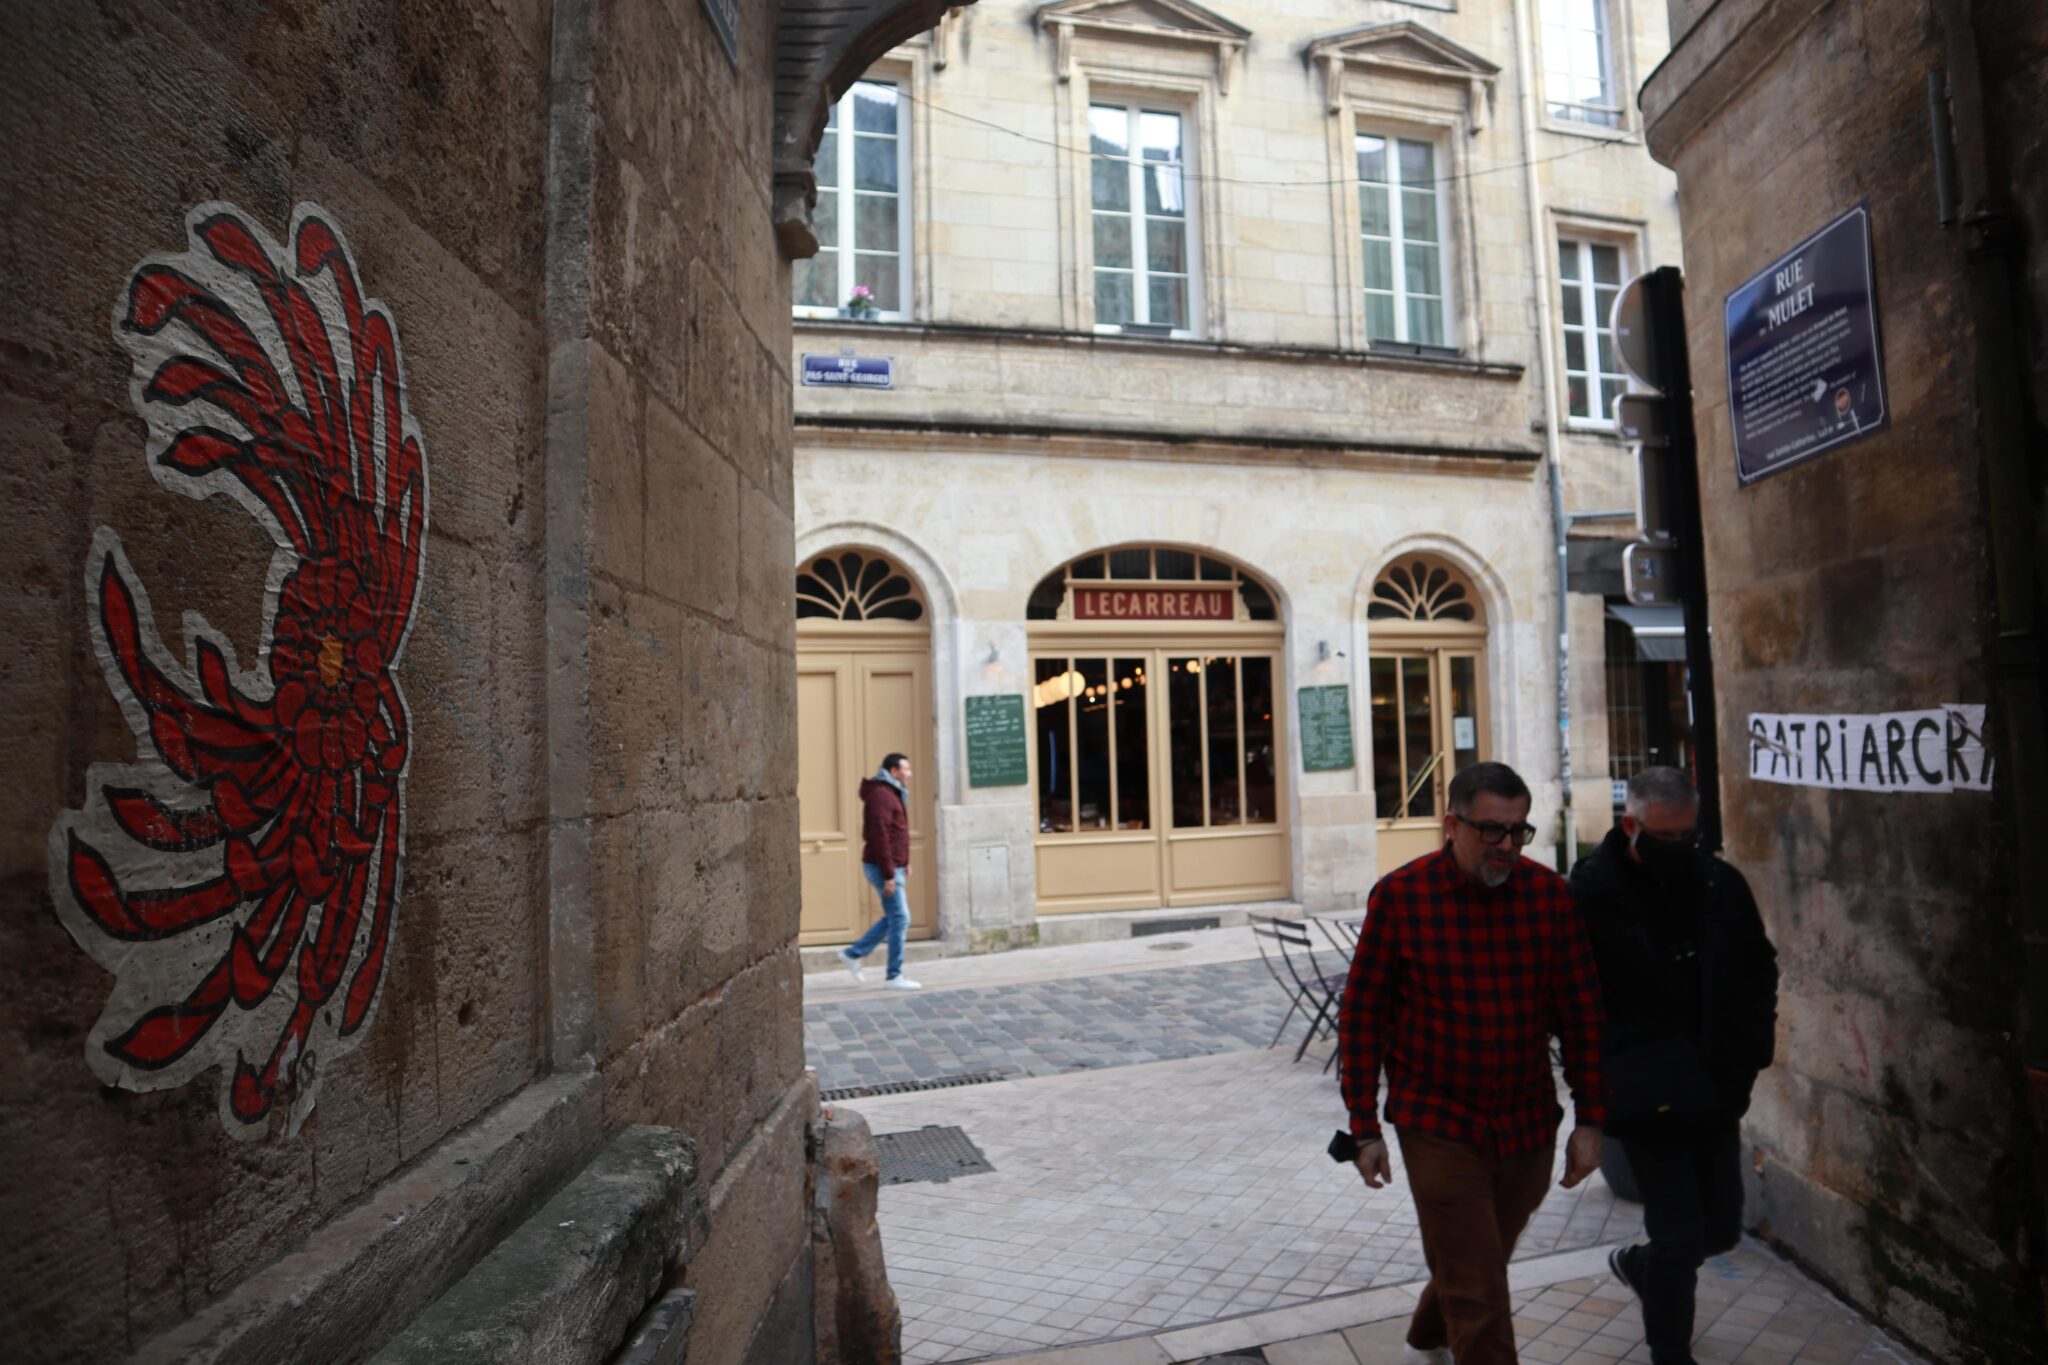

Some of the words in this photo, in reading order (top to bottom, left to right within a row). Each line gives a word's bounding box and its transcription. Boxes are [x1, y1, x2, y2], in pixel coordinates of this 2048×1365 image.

[1776, 258, 1804, 296] RUE
[1768, 282, 1816, 331] MULET
[1084, 591, 1223, 617] LECARREAU
